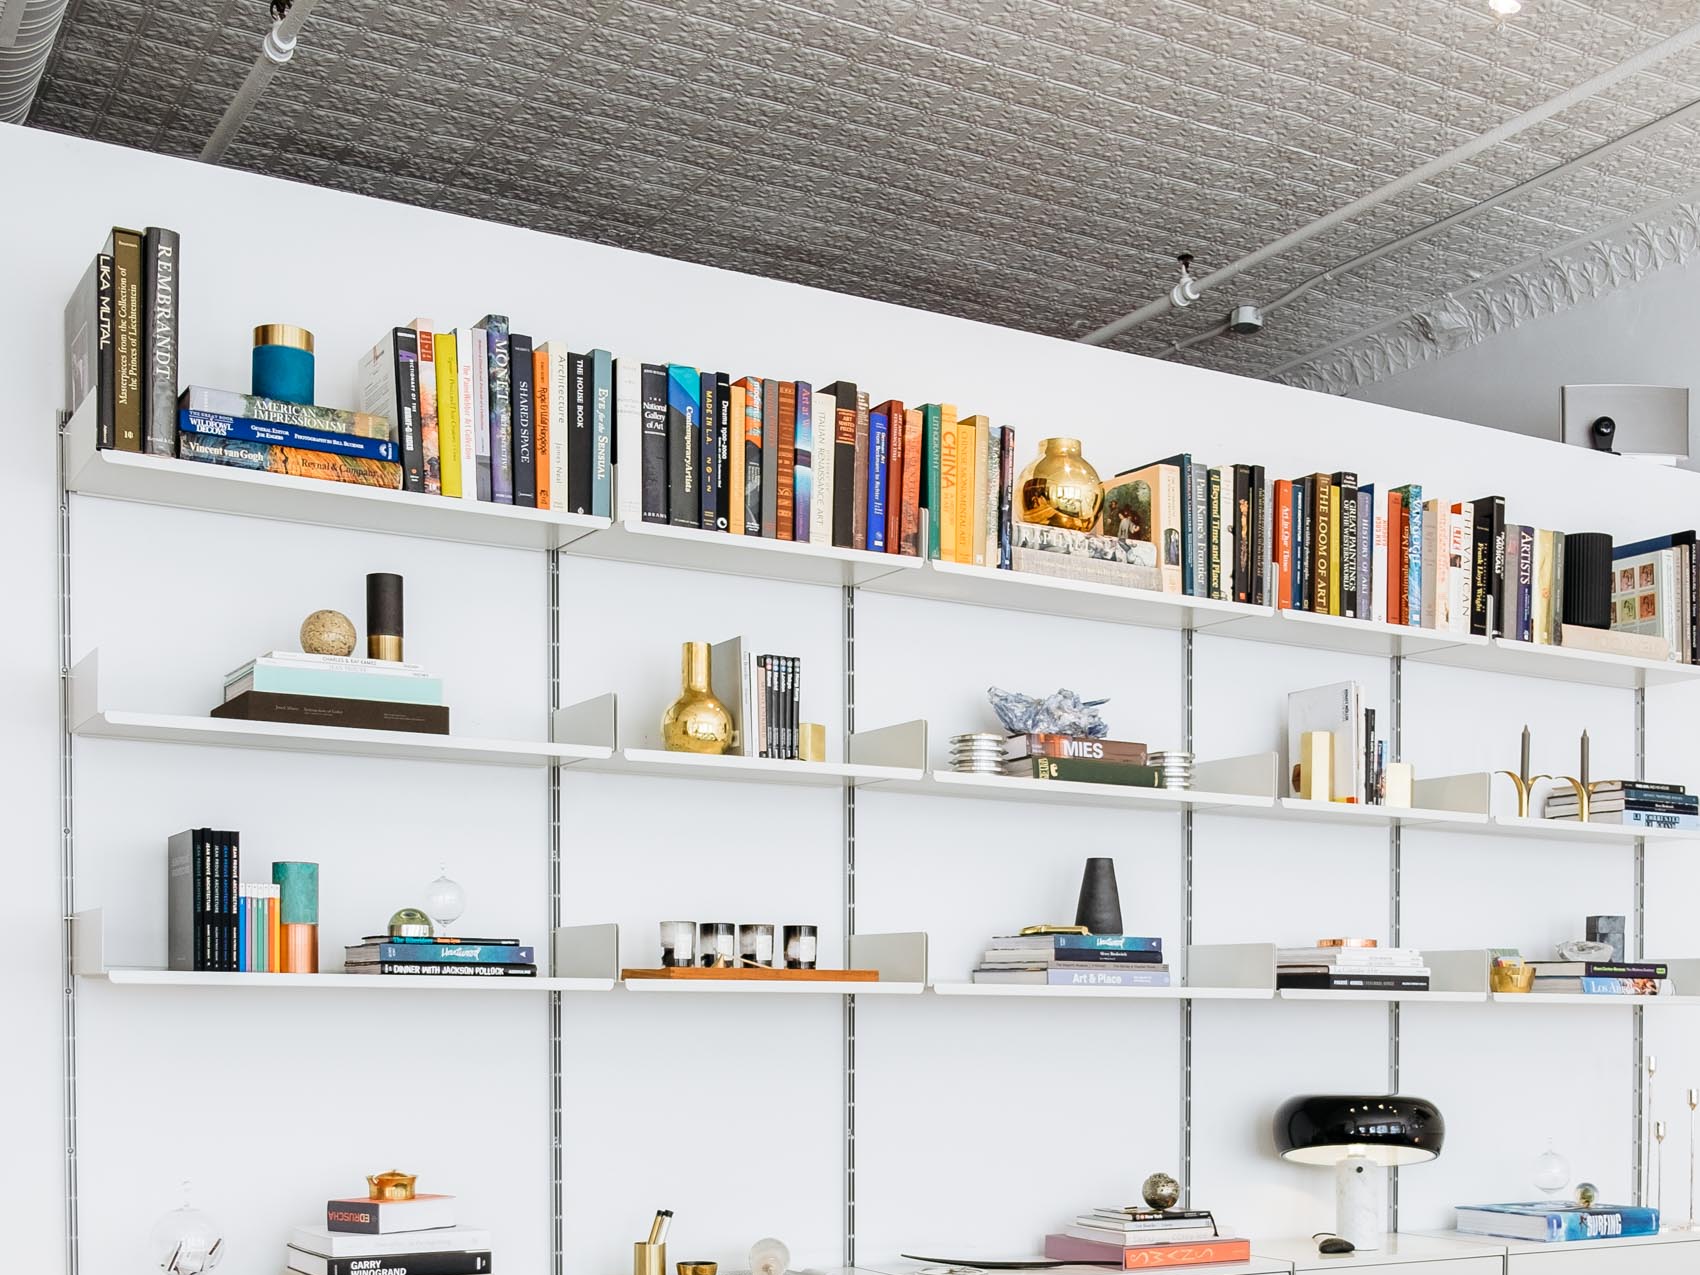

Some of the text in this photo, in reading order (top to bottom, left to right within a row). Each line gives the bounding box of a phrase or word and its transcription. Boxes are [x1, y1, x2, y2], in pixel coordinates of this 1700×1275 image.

[99, 255, 111, 350] LIKA MUTAL
[155, 243, 173, 380] REMBRANDT
[117, 265, 128, 405] Masterpieces from the Collection of
[128, 284, 138, 390] the Princes of Liechtenstein
[495, 340, 510, 403] MONET
[558, 355, 567, 423] Architecture
[576, 360, 584, 428] THE HOUSE BOOK
[597, 388, 609, 410] EYE
[253, 401, 317, 418] AMERICAN
[642, 401, 667, 413] National
[705, 391, 714, 415] MADE
[721, 400, 729, 425] Dreams
[801, 388, 811, 416] Art at
[189, 417, 234, 431] WILDFOWL
[253, 409, 347, 433] IMPRESSIONISM
[519, 381, 531, 463] SHARED SPACE
[596, 410, 605, 421] for
[643, 411, 666, 423] Gallery
[646, 421, 664, 431] of Art
[705, 416, 714, 426] IN
[196, 425, 228, 436] DECOYS
[705, 428, 714, 446] L.A.
[932, 415, 940, 470] LITHOGRAPHY
[189, 441, 264, 462] Vincent van Gogh
[597, 435, 609, 480] SENSUAL
[942, 431, 956, 490] CHINA
[302, 458, 330, 469] Reynal
[330, 463, 338, 471] &
[815, 412, 827, 526] ITALIAN RENAISSANCE ART
[959, 431, 969, 546] CHINESE MONUMENTAL ART
[1282, 506, 1291, 520] Art
[1343, 500, 1350, 510] OF
[1411, 499, 1422, 524] VAN
[1196, 478, 1207, 584] Paul Kane's Frontier
[1210, 484, 1221, 588] Beyond Time and Place
[1317, 486, 1330, 606] THE LOOM OF ART
[1349, 500, 1357, 592] GREAT PAINTINGS
[1361, 519, 1371, 595] HISTORY OF ART
[1494, 535, 1503, 575] MUSICALS
[1519, 531, 1534, 586] ARTISTS
[1401, 525, 1410, 601] Animals and Men
[1461, 510, 1472, 617] THE VATICAN
[1475, 542, 1485, 613] Frank Lloyd Wright
[322, 655, 345, 664] CHARLES
[1064, 740, 1104, 760] MIES
[393, 965, 505, 976] DINNER WITH JACKSON POLLOCK
[1072, 973, 1122, 985] Art & Place
[1587, 1213, 1622, 1237] SURFING
[350, 1259, 382, 1270] GARRY
[1130, 1247, 1214, 1265] SWANS
